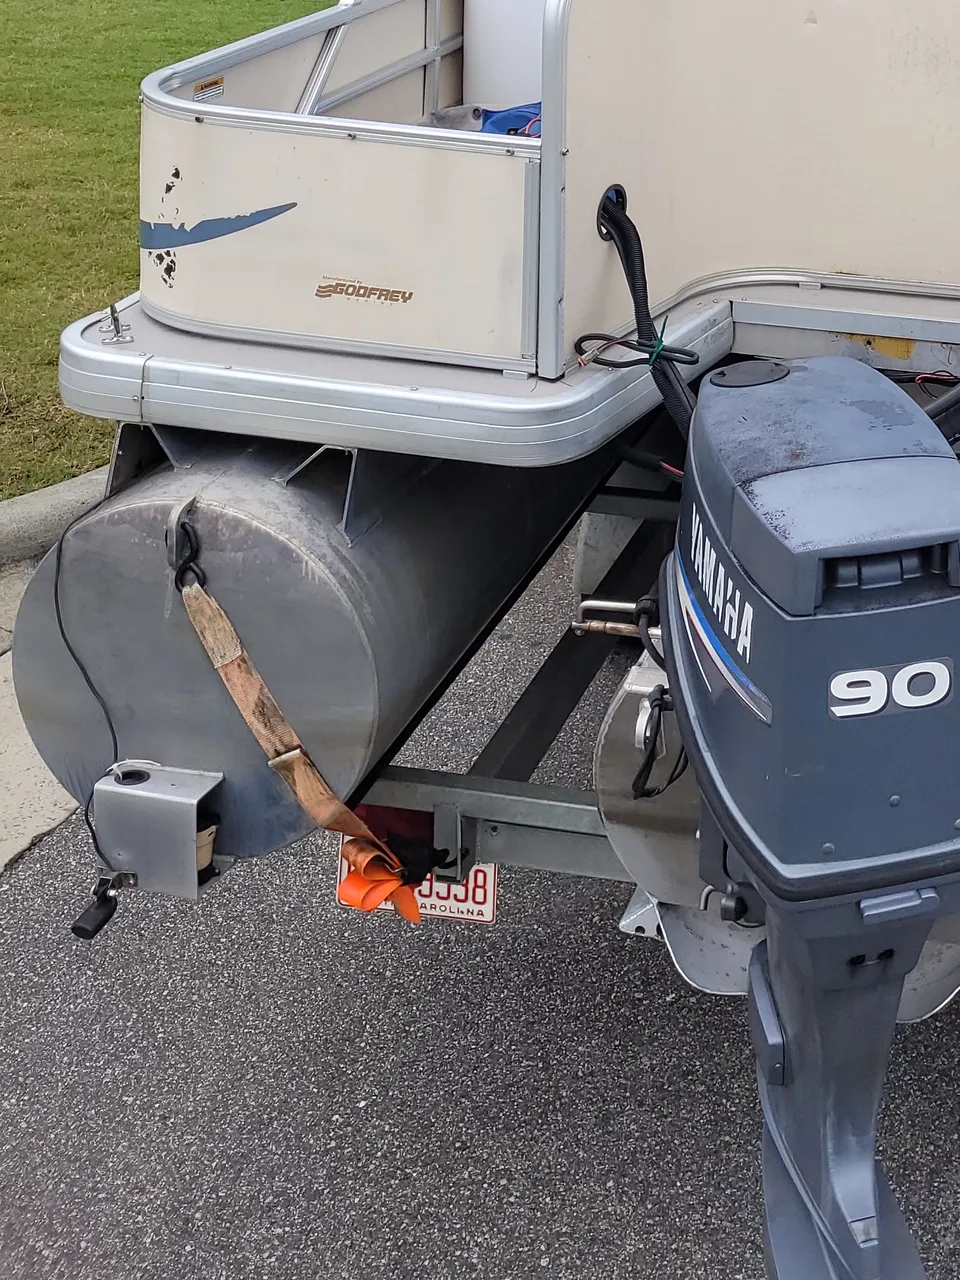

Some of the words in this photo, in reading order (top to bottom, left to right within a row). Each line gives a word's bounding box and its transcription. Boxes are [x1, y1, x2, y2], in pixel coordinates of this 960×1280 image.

[331, 282, 414, 304] GODFREY
[691, 502, 754, 664] YAMAHA
[830, 662, 951, 717] 90
[420, 902, 484, 917] AROLINA
